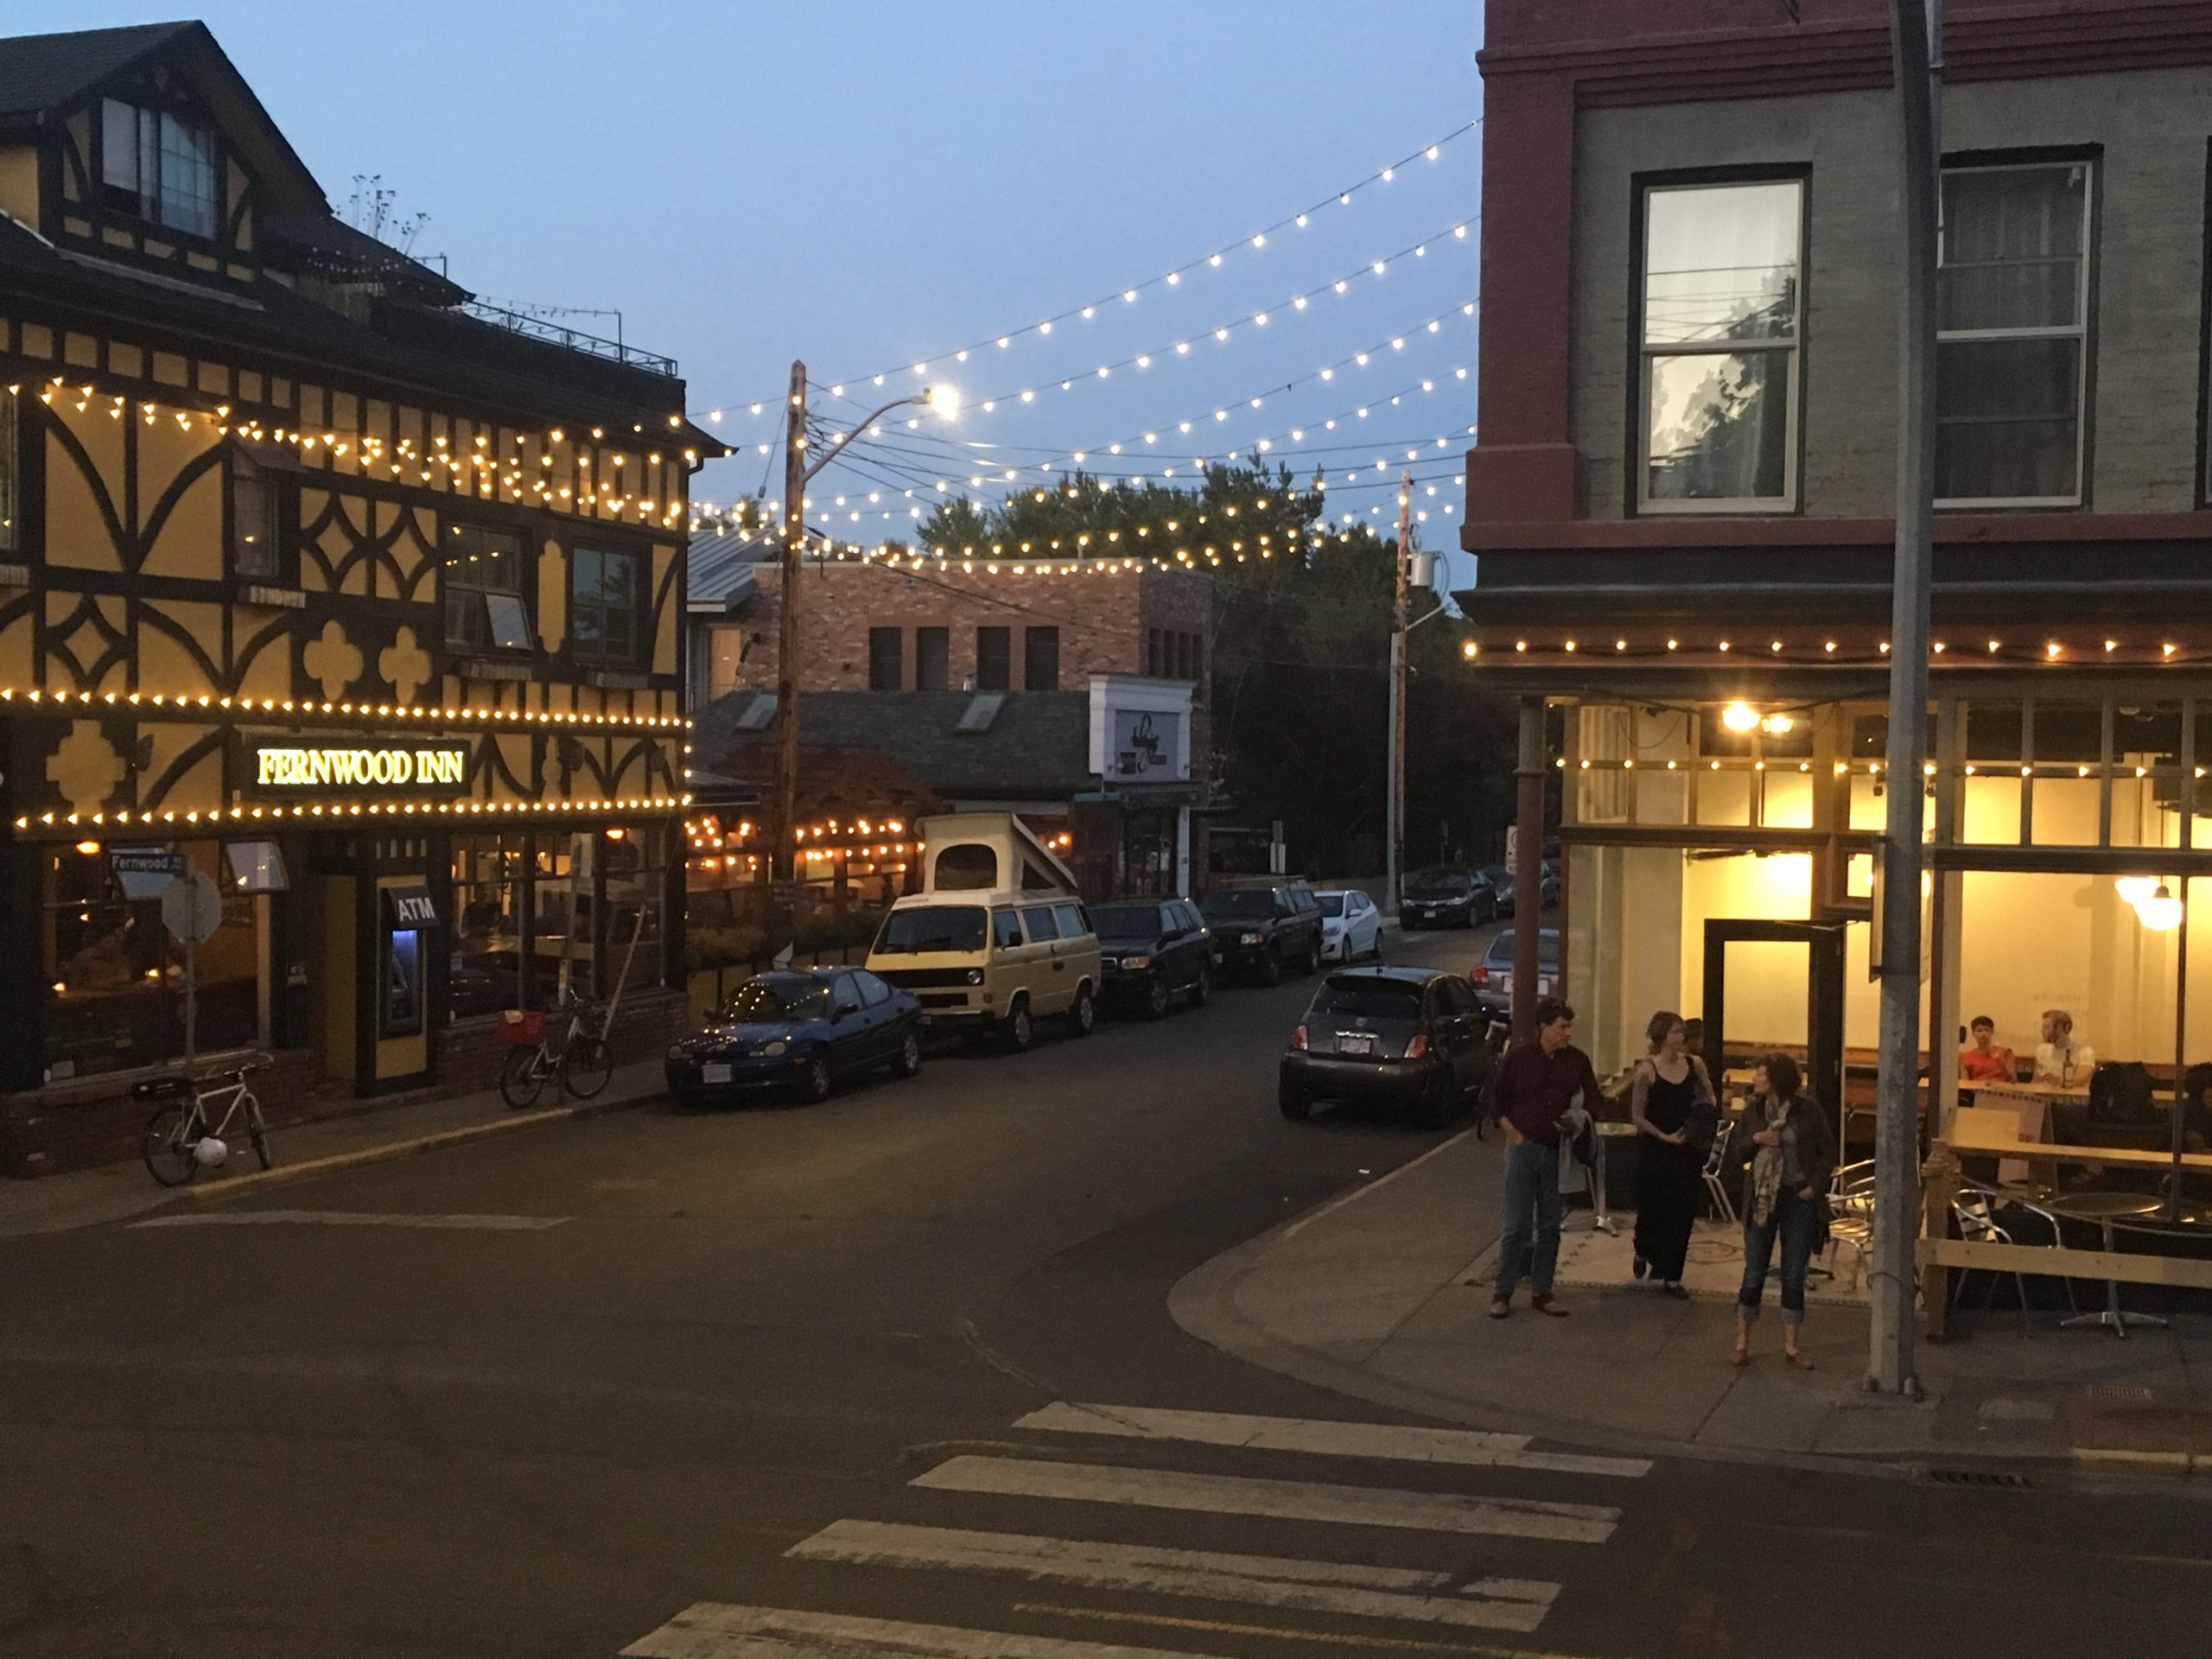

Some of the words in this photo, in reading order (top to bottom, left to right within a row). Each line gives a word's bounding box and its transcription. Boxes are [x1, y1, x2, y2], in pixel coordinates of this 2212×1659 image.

[257, 748, 412, 785] FERNWOOD
[416, 750, 464, 784] INN
[111, 855, 168, 869] Fernwood
[398, 897, 435, 922] ATM
